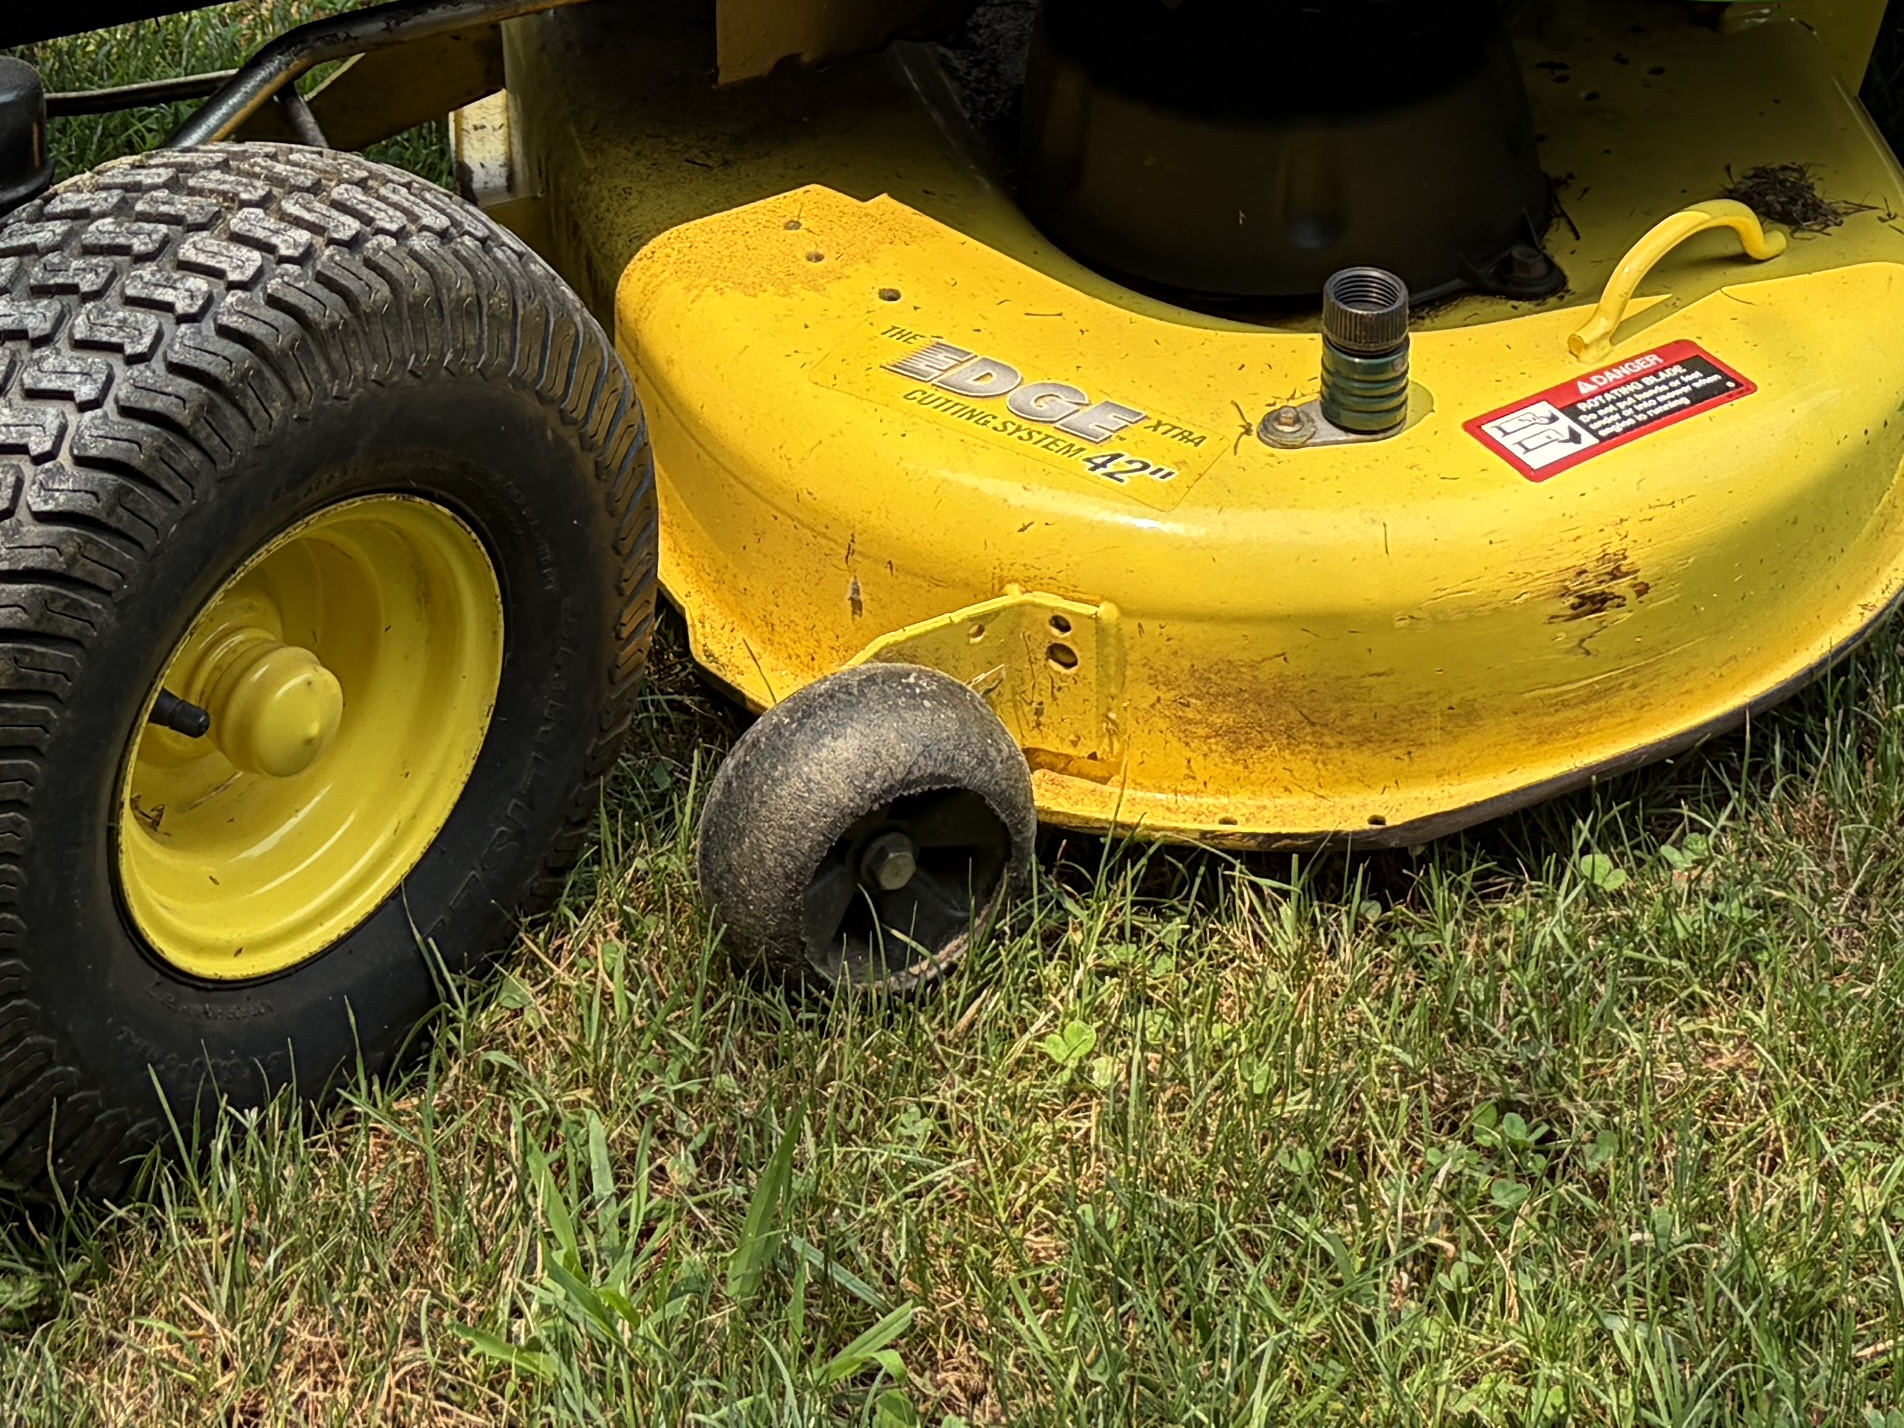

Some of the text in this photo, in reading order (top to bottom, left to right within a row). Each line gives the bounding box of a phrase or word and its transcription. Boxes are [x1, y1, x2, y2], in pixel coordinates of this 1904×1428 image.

[880, 324, 925, 347] THE
[879, 338, 1147, 445] EDGE
[1576, 364, 1688, 412] ROTATING BLADE
[1590, 353, 1665, 387] DANGER
[1577, 412, 1598, 424] Do
[1597, 405, 1618, 417] not
[1616, 396, 1636, 410] put
[1634, 384, 1669, 402] hands
[1669, 378, 1681, 388] or
[1589, 411, 1622, 430] under
[1621, 407, 1634, 417] or
[1656, 384, 1693, 403] mower
[1691, 373, 1722, 389] when
[1597, 417, 1637, 437] engine
[1646, 396, 1692, 418] running
[902, 387, 1178, 485] CUTTING SYSTEM 42"
[1143, 417, 1209, 449] XTRA
